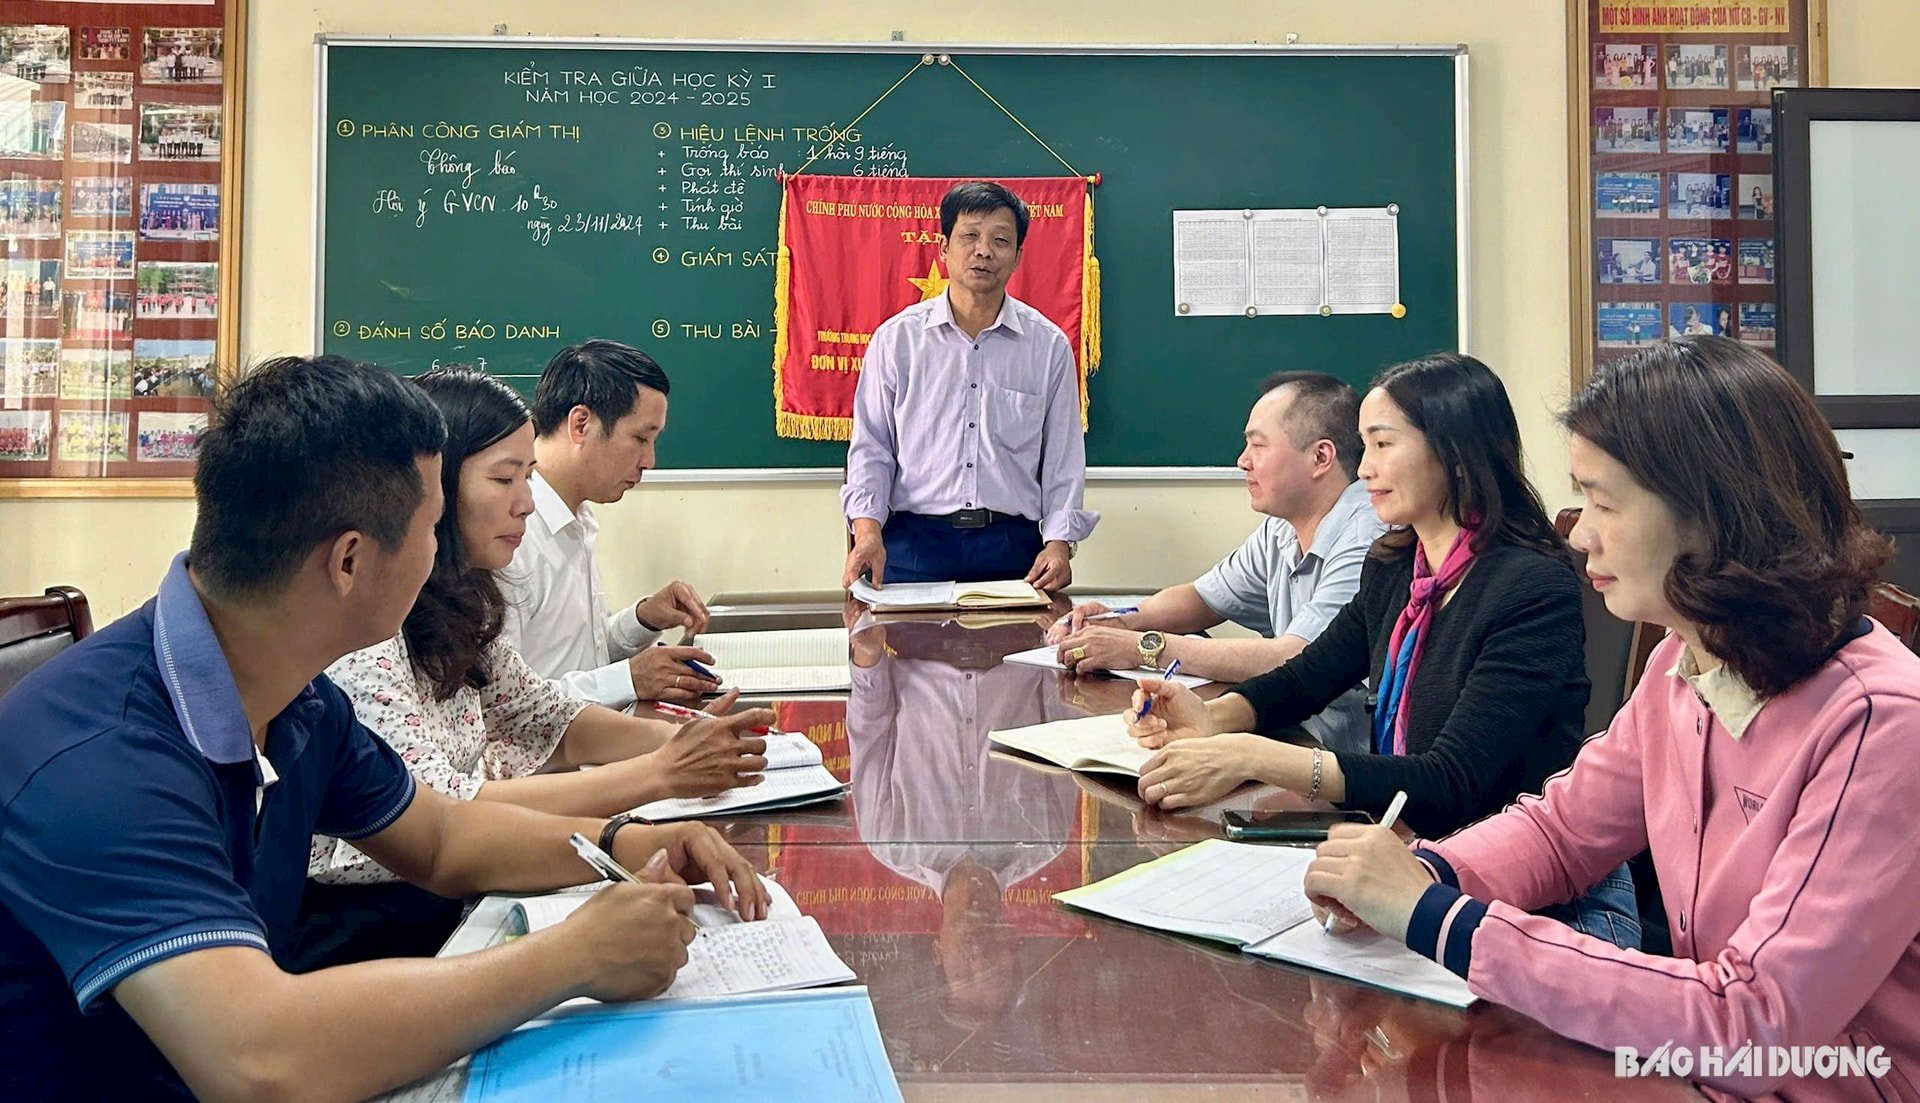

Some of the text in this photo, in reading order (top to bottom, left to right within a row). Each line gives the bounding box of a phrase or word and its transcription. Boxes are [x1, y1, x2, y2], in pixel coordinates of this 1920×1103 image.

[1759, 7, 1768, 26] GV
[1774, 7, 1785, 26] NV
[504, 61, 776, 92] KIỂM TRA GIỮA HỌC KỲ I
[580, 90, 620, 106] HỌC
[630, 92, 679, 105] 2024
[701, 92, 752, 106] 2025
[362, 122, 414, 138] PHÂN
[422, 120, 480, 138] CÔNG
[488, 120, 540, 139] GIÁM
[549, 125, 580, 142] THỊ
[680, 124, 724, 144] HIỆU
[734, 124, 784, 145] LỆNH
[792, 122, 862, 142] TRỐNG
[682, 144, 729, 168] Trống
[736, 144, 769, 160] báo
[824, 142, 851, 160] hồi
[854, 146, 865, 160] 9
[868, 142, 908, 168] tiếng
[420, 148, 516, 189] Thông báo
[681, 163, 712, 178] Gọi
[720, 162, 744, 178] thí
[853, 164, 864, 176] 6
[682, 181, 719, 195] Phát
[724, 178, 747, 195] đề
[416, 188, 432, 228] ý
[444, 190, 496, 214] GVCN
[682, 198, 717, 214] Tính
[720, 200, 744, 222] giờ
[806, 200, 835, 216] CHÍNH
[838, 198, 858, 217] PHỦ
[858, 200, 885, 218] NƯỚC
[886, 201, 913, 222] CỘNG
[914, 203, 933, 218] HÒA
[1043, 204, 1064, 218] NAM
[682, 216, 710, 230] Thu
[718, 216, 743, 230] bài
[681, 246, 732, 267] GIÁM
[742, 247, 778, 266] SÁT
[358, 320, 411, 340] ĐÁNH
[420, 318, 448, 340] SỐ
[456, 320, 496, 340] BÁO
[506, 324, 560, 339] DANH
[681, 324, 722, 338] THU
[732, 320, 760, 339] BÀI
[810, 354, 834, 370] ĐƠN
[836, 356, 848, 374] VỊ
